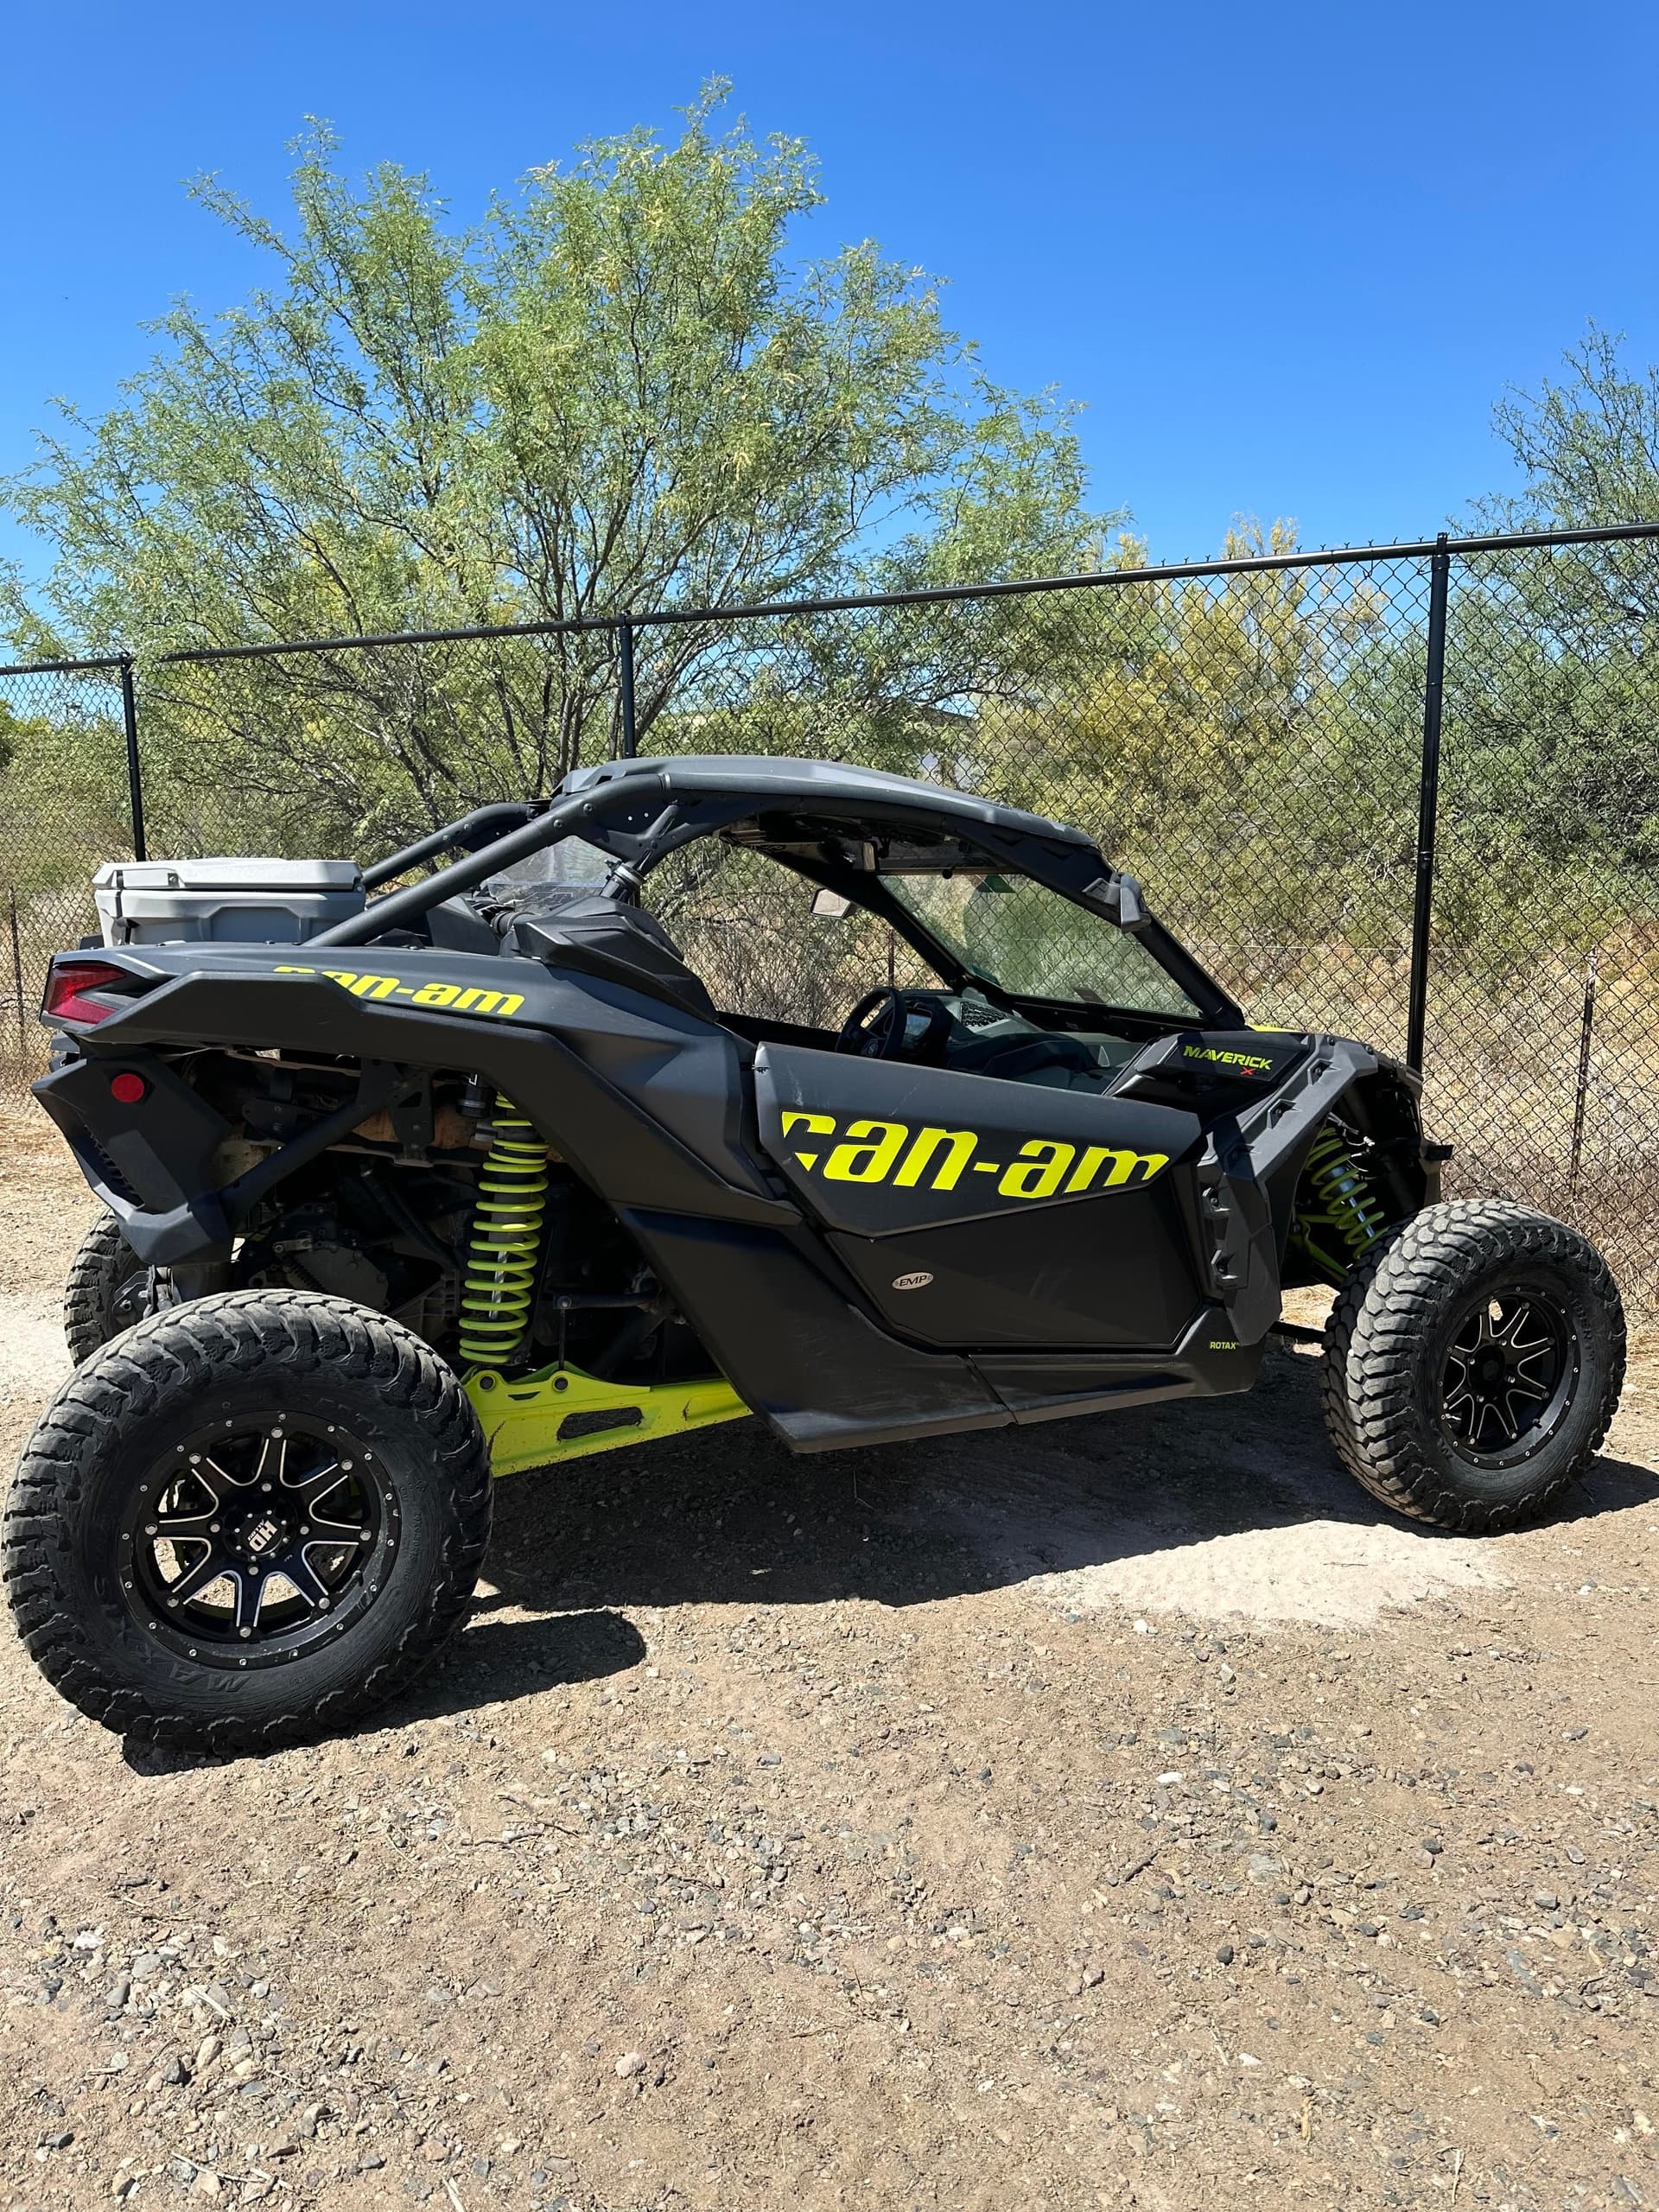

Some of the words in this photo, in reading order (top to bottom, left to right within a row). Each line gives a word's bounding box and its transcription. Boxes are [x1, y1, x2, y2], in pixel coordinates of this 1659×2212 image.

[273, 965, 525, 1016] n-am
[1183, 1046, 1273, 1070] MAVERICK
[899, 1274, 927, 1287] EMP
[1210, 1341, 1236, 1350] ROTAX
[249, 1520, 278, 1552] HD
